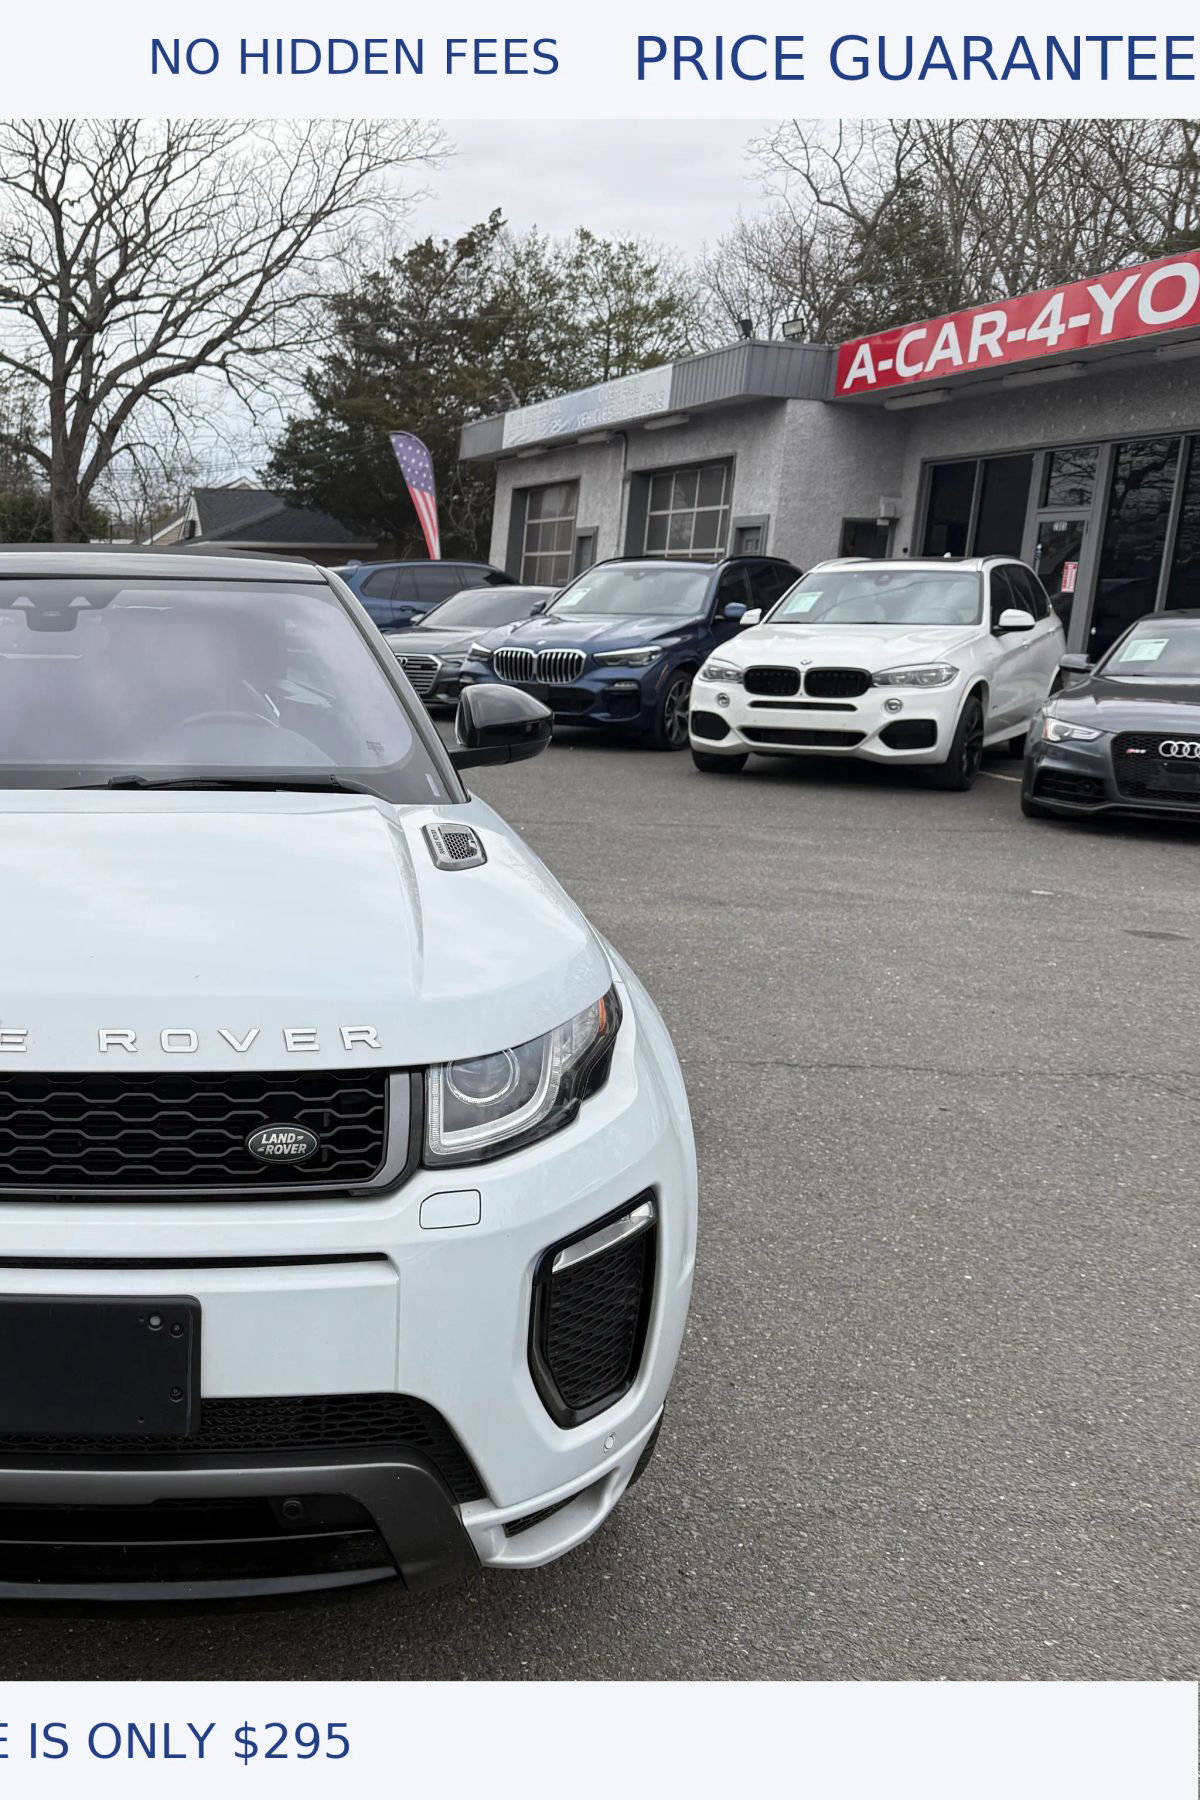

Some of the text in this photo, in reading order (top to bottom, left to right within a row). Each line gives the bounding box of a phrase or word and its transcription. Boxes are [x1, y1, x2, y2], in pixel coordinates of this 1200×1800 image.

[98, 1024, 384, 1054] ROVER
[261, 1133, 296, 1144] LAND
[264, 1144, 307, 1155] ROVER
